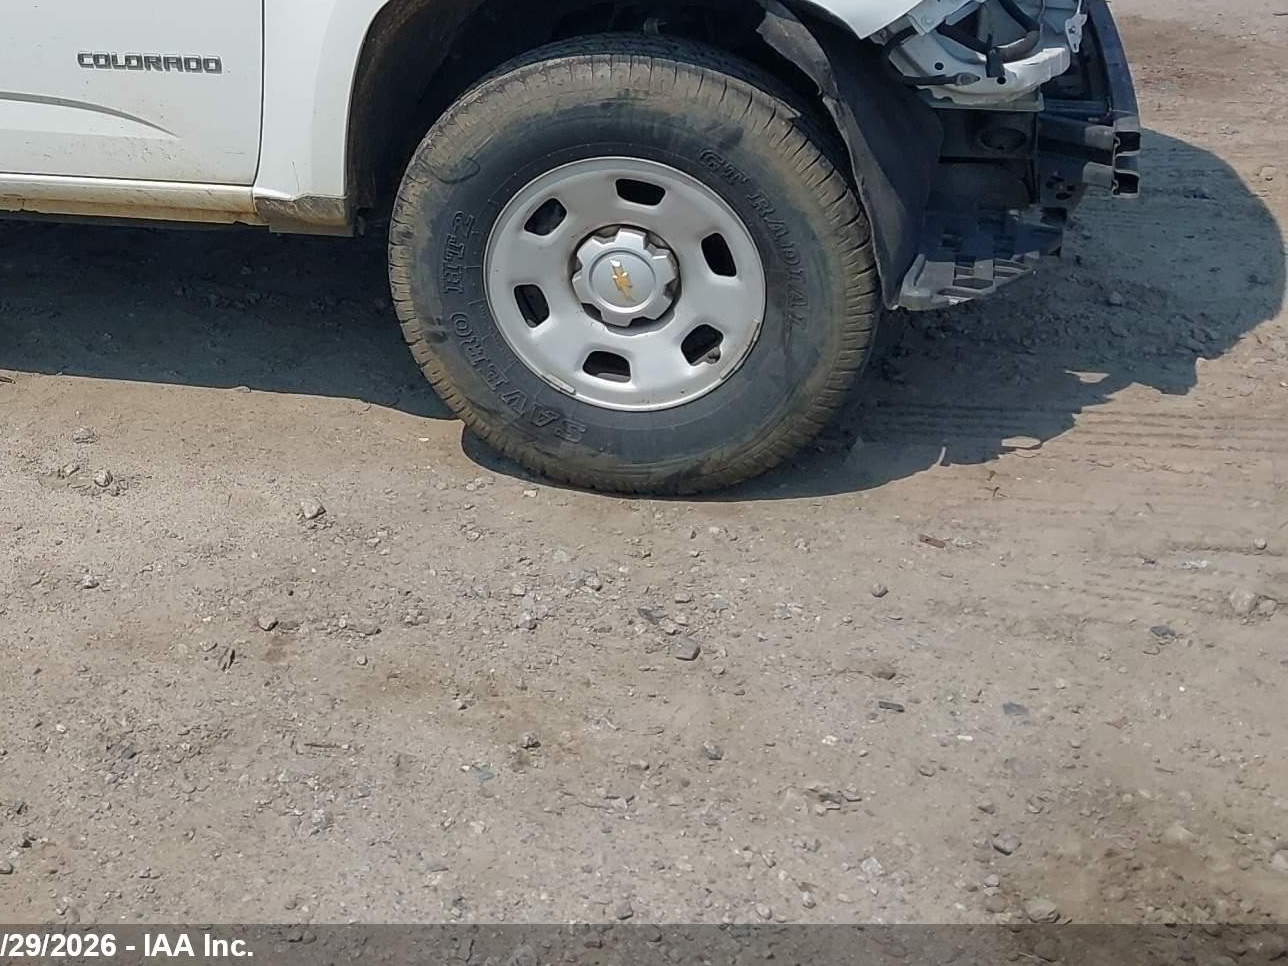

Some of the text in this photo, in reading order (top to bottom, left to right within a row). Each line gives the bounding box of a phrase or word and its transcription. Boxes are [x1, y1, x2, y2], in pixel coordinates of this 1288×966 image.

[77, 50, 223, 75] COLORADO
[443, 210, 589, 443] SAVERO HT2
[698, 148, 809, 331] GT RADIAL
